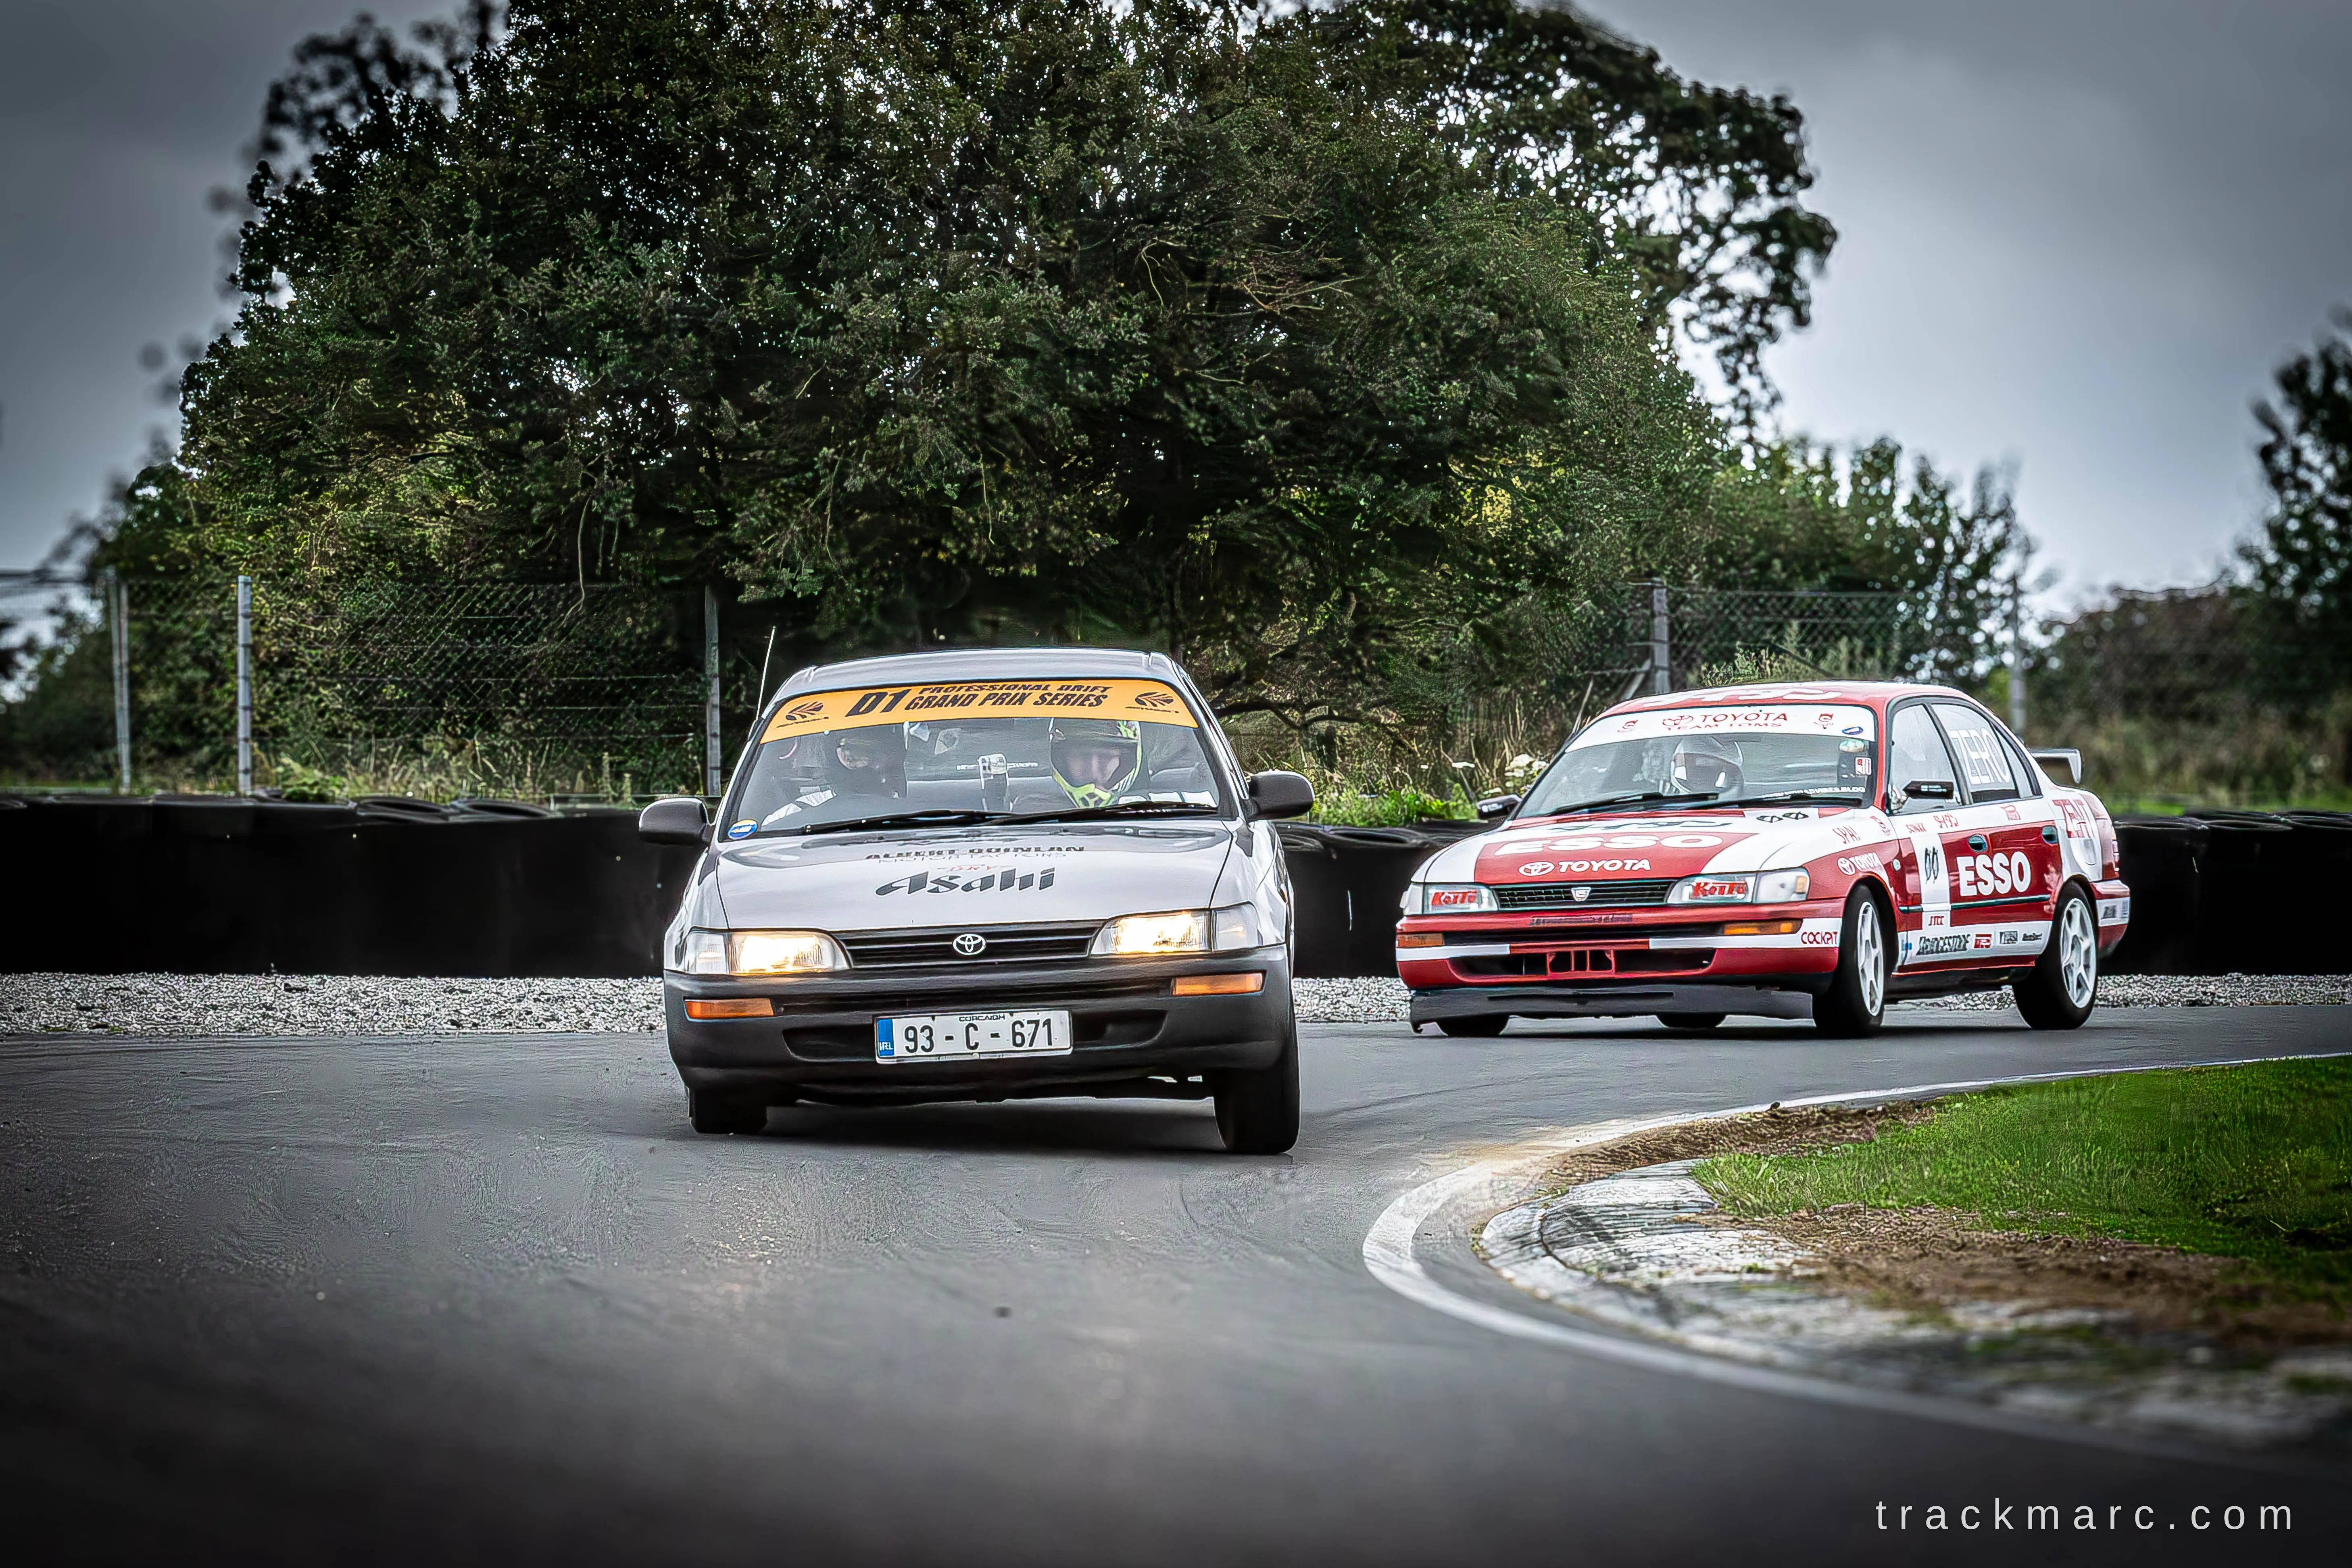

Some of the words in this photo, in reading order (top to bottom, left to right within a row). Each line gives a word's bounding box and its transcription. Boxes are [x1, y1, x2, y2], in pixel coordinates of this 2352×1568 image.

[918, 684, 1051, 694] PROFESSIONAL
[845, 689, 911, 717] D1
[904, 694, 979, 710] GRAND
[978, 692, 1032, 706] PRIX
[1033, 692, 1108, 707] SERIES
[1700, 713, 1788, 723] TOYOTA
[1494, 834, 1723, 856] ESSO
[1558, 859, 1651, 873] TOYOTA
[1956, 851, 2031, 897] ESSO
[876, 867, 1055, 896] Asahi
